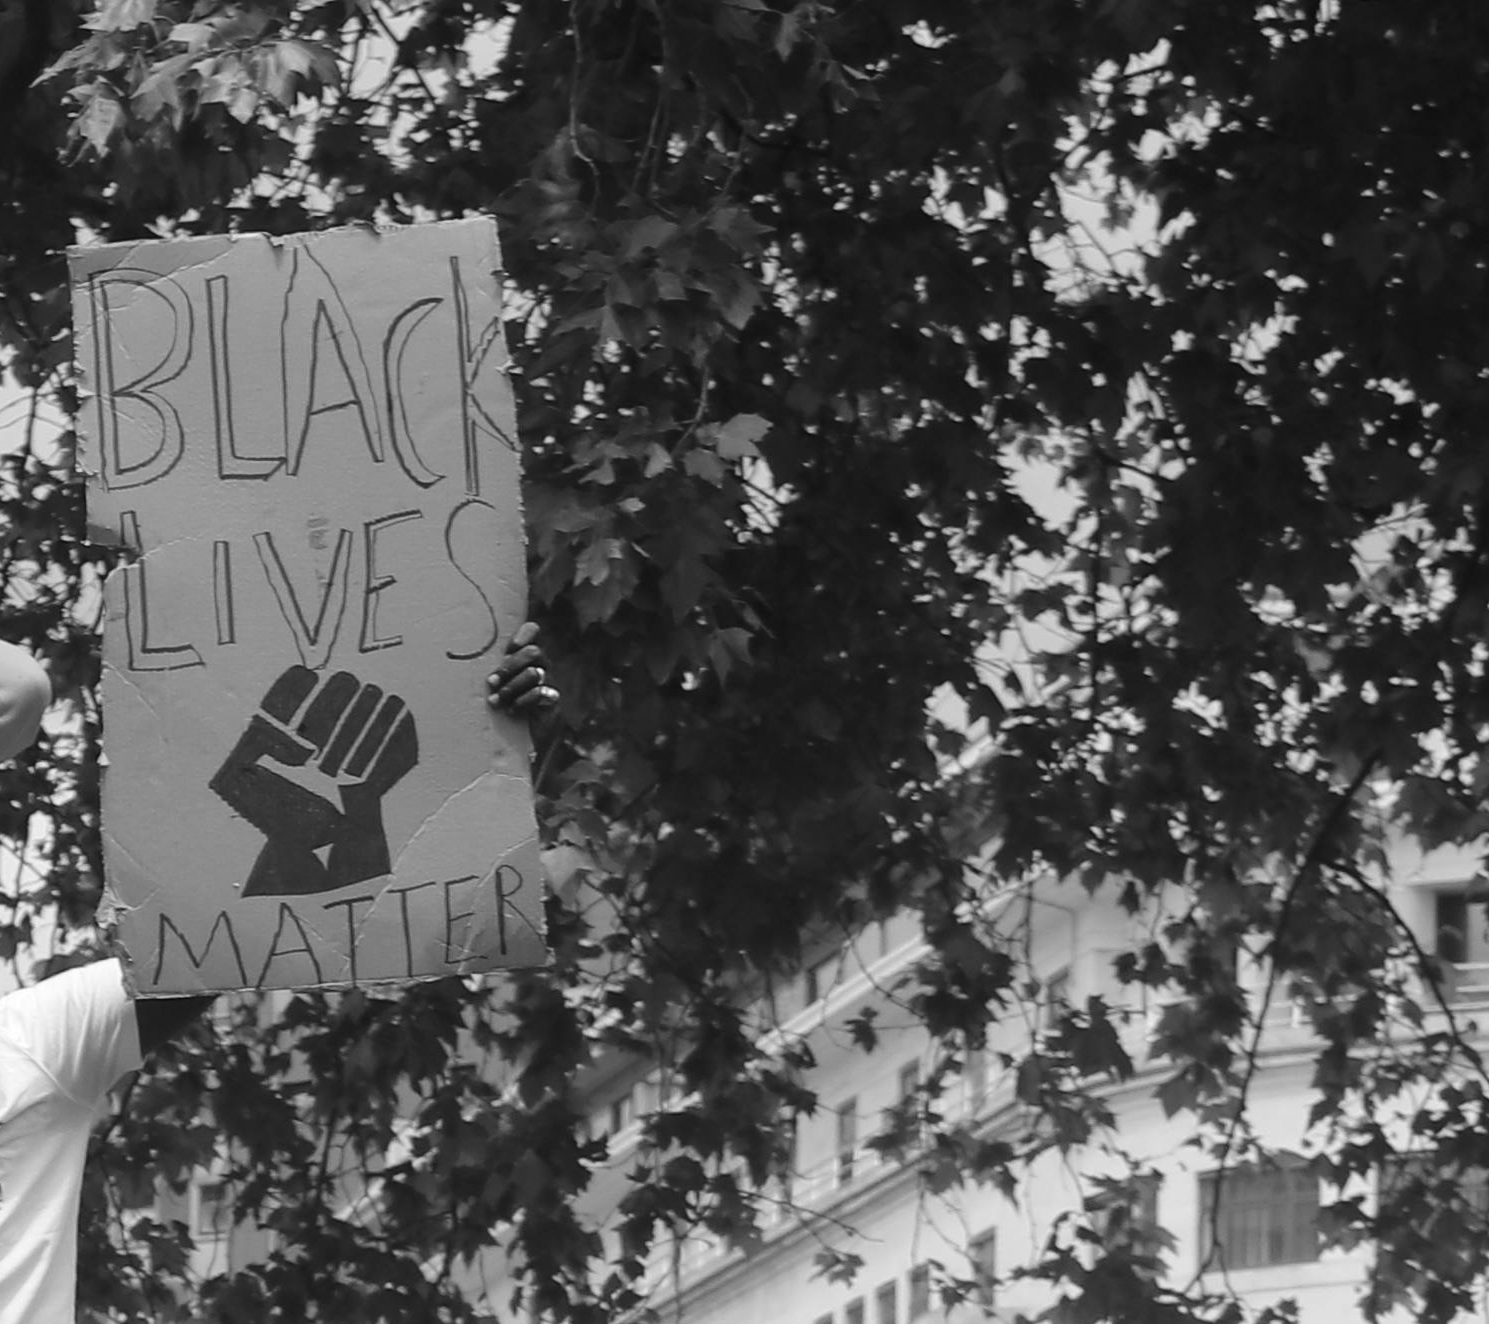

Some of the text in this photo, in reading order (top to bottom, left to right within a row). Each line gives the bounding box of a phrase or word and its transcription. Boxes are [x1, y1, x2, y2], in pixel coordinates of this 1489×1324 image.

[88, 242, 521, 497] BLACK
[120, 499, 497, 671] LIVES
[153, 863, 548, 989] MATTER
